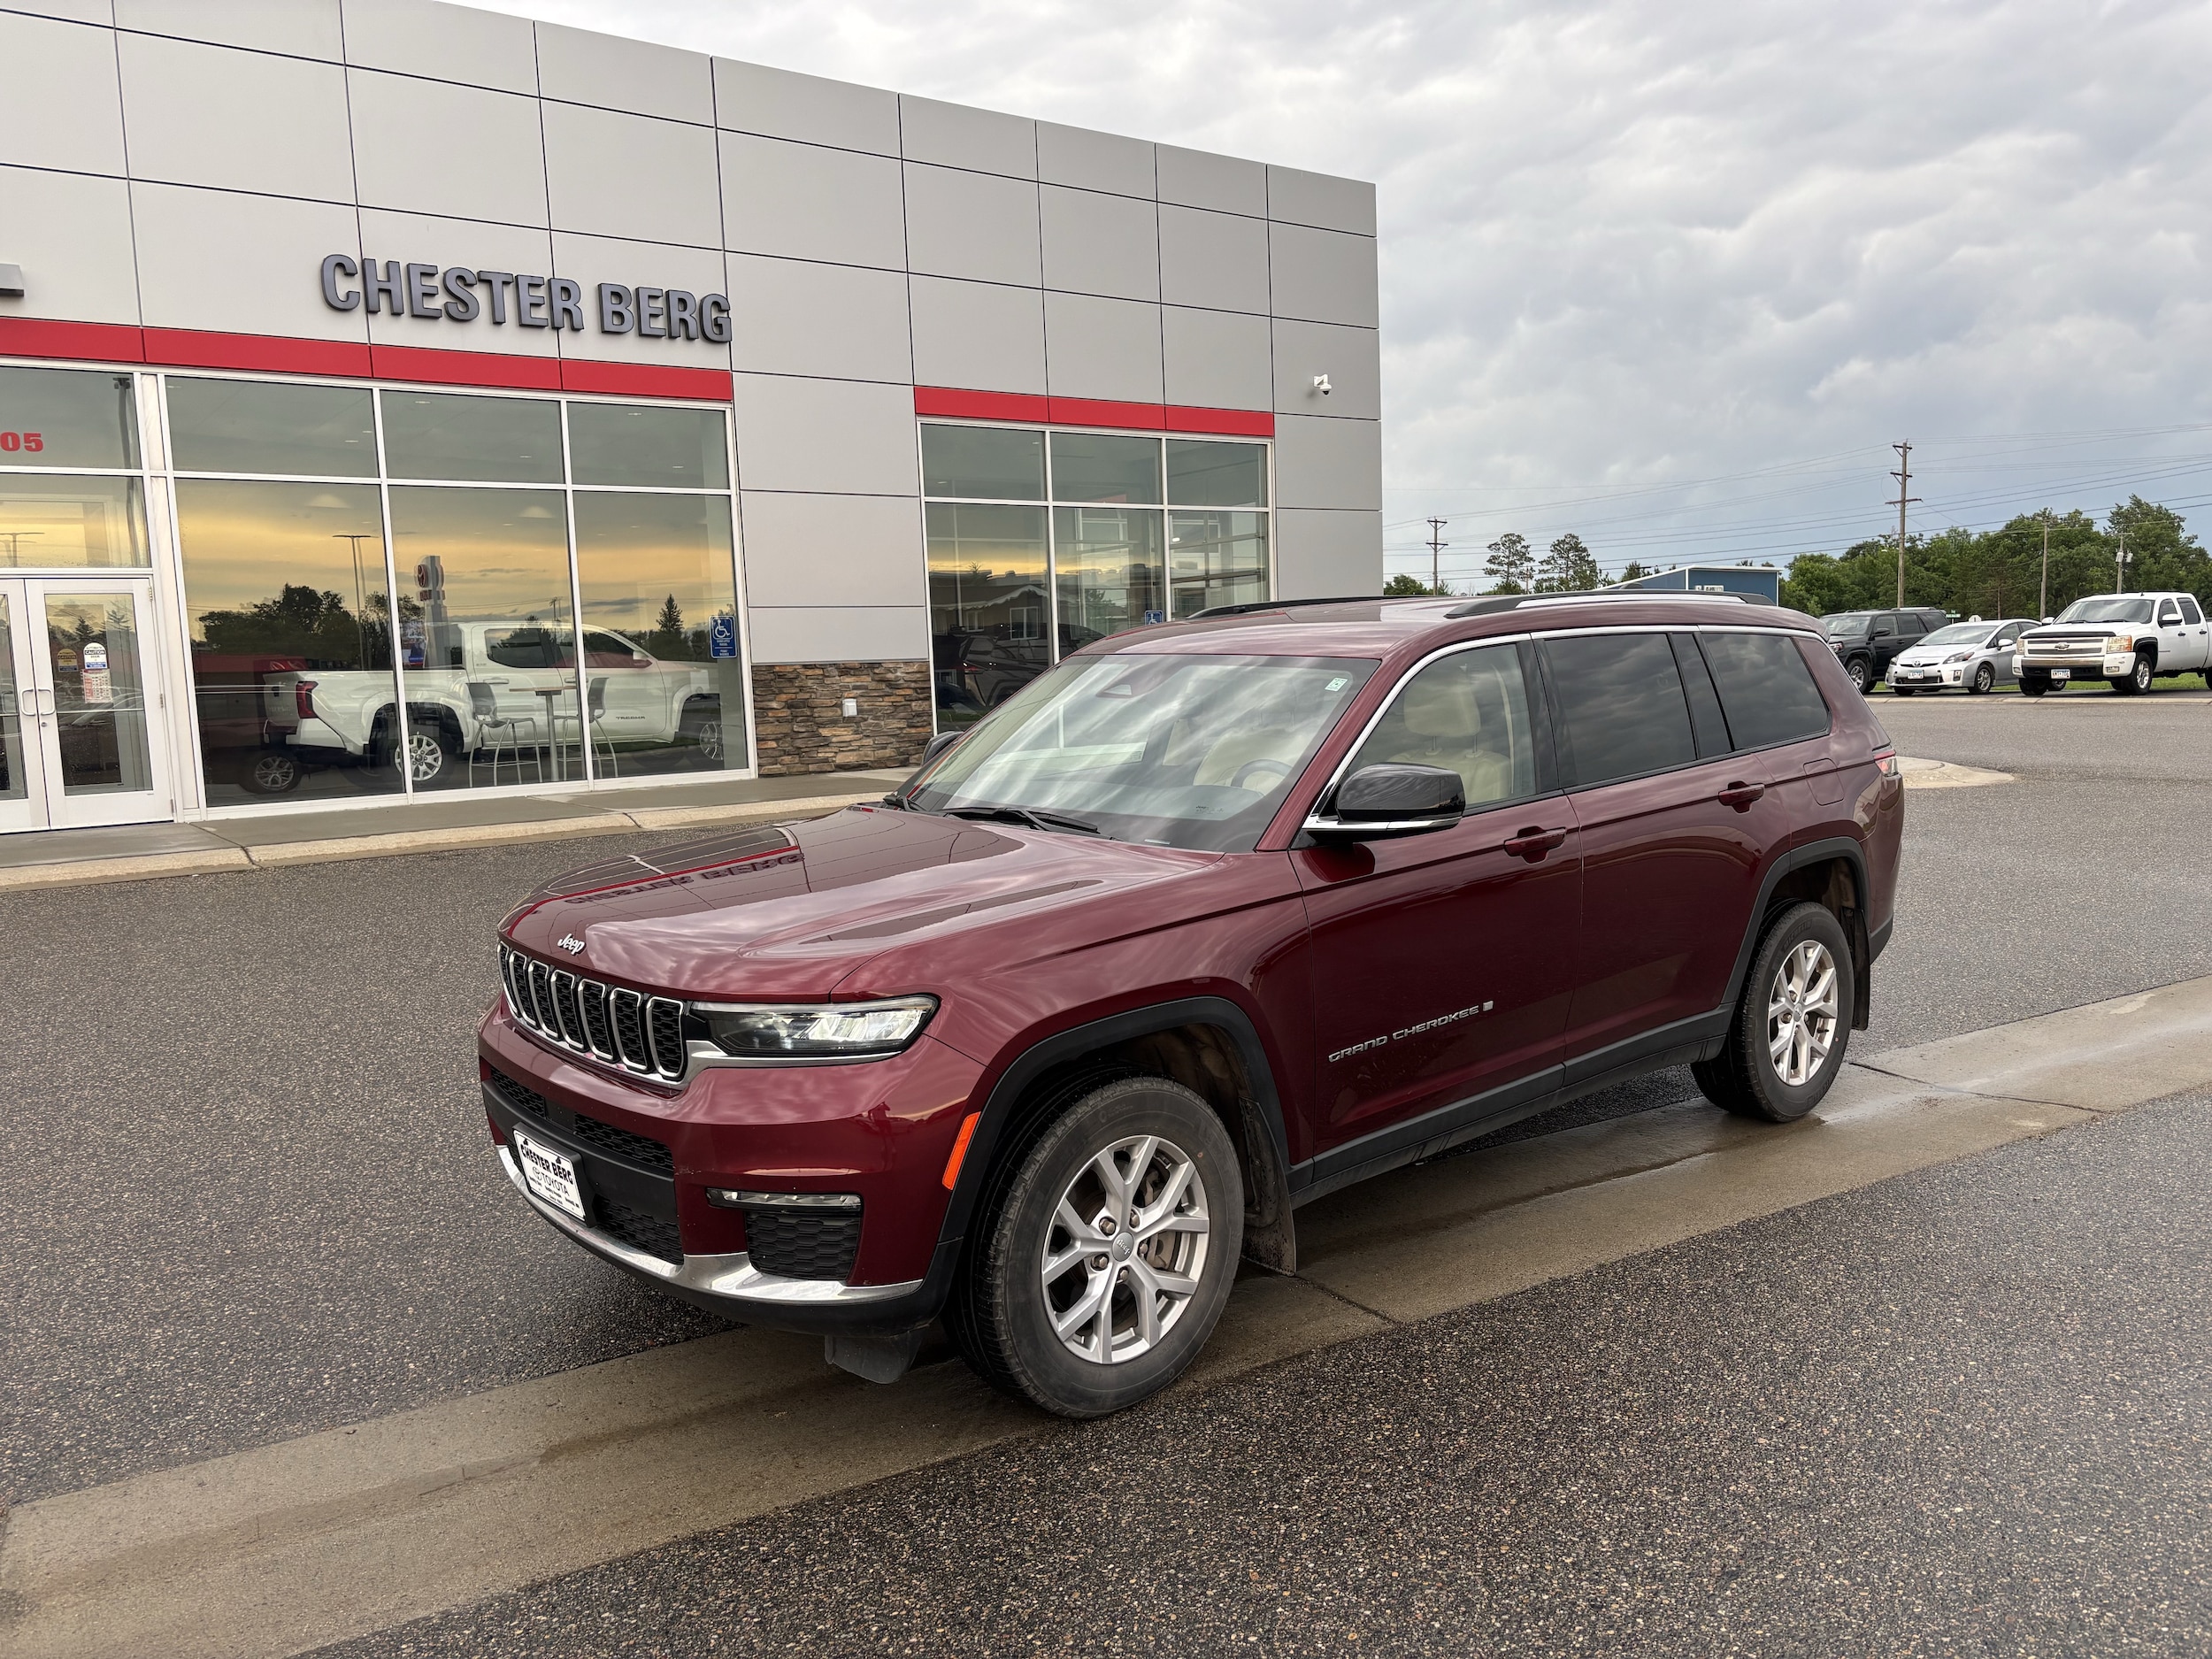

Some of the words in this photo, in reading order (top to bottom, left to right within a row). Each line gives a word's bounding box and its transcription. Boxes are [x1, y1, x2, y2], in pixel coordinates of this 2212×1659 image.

[321, 254, 585, 332] CHESTER
[597, 282, 733, 342] BERG
[0, 431, 43, 452] 05
[557, 933, 586, 955] Jeep
[1328, 1035, 1388, 1063] GRAND
[1392, 1005, 1479, 1041] CHEROKEE
[520, 1143, 552, 1174] CHESTER
[551, 1162, 574, 1186] BERG
[541, 1172, 571, 1197] TOYOTA
